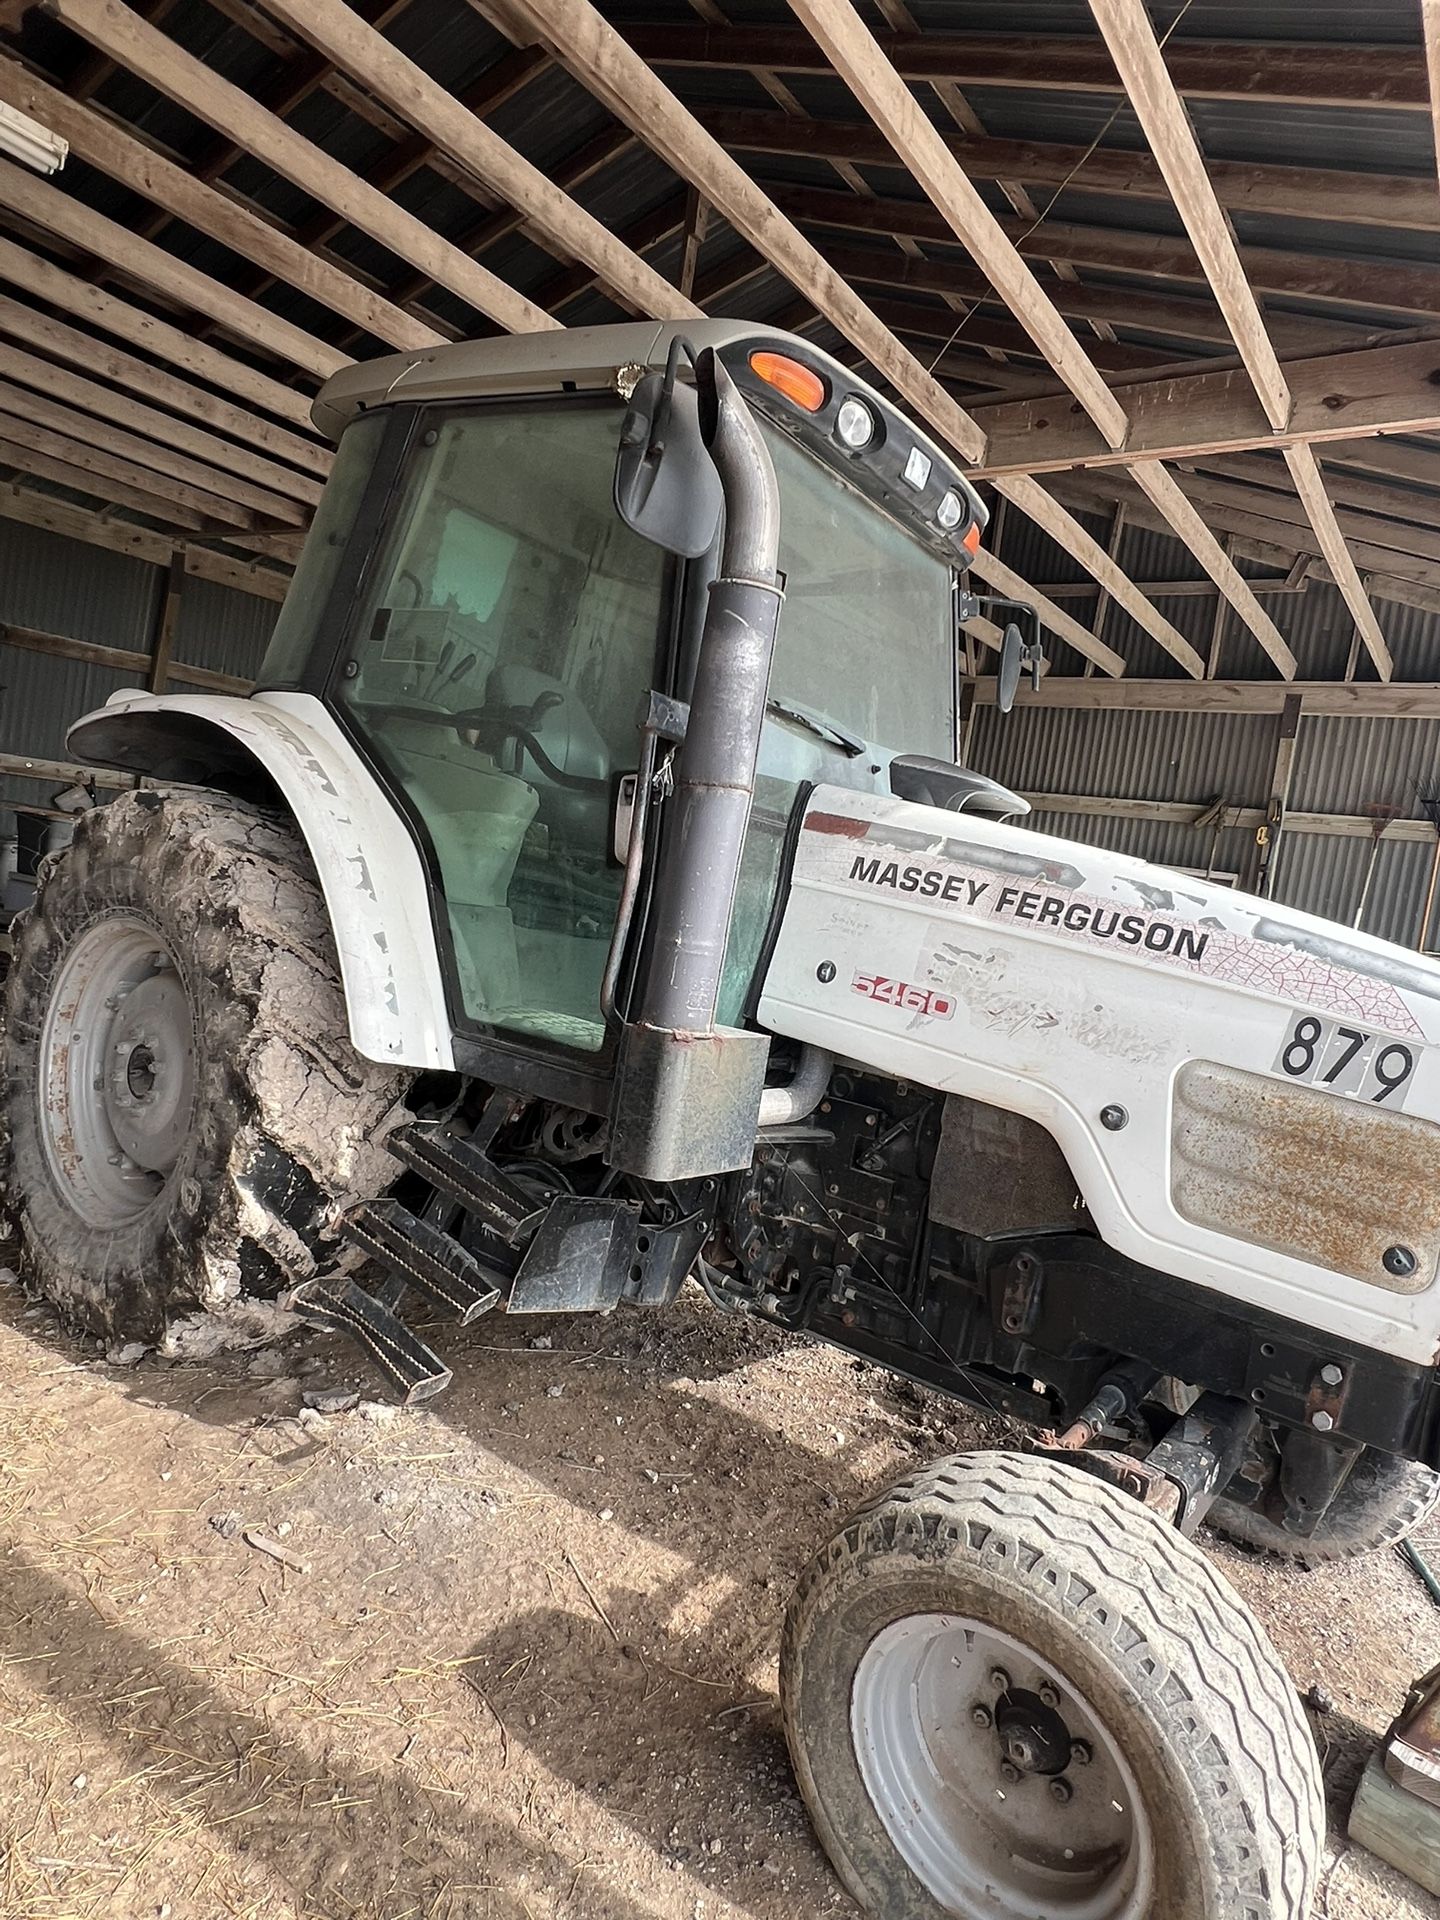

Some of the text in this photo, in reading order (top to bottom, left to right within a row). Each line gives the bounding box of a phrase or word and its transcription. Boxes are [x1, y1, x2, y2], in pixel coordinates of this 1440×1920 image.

[849, 857, 1210, 962] MASSEY FERGUSON
[850, 968, 957, 1021] 5460
[1282, 1016, 1413, 1103] 879
